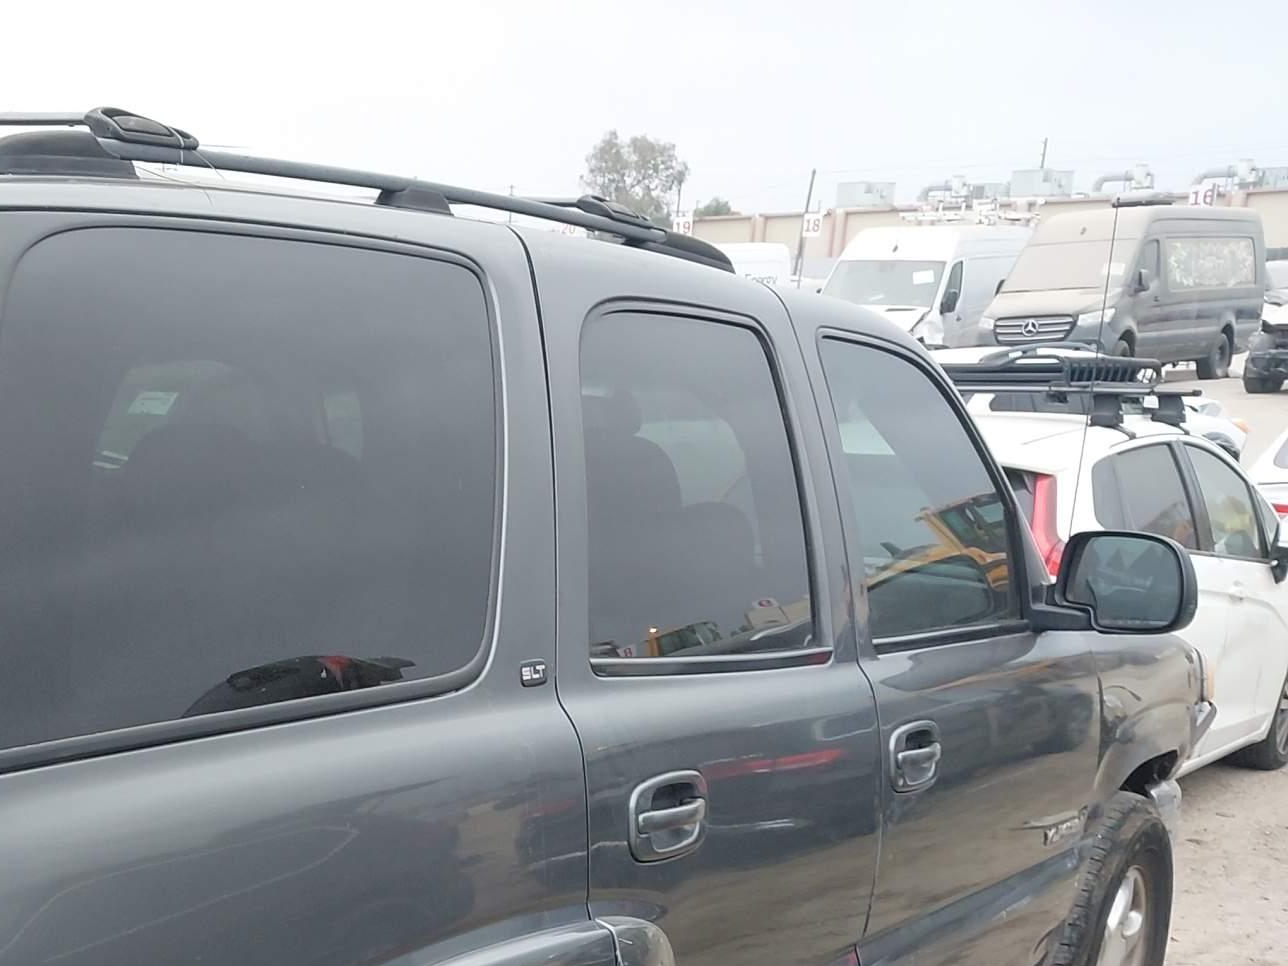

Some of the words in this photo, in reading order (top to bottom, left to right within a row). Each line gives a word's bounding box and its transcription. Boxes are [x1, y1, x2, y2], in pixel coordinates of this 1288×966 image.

[675, 221, 691, 233] 19
[804, 218, 821, 232] 18
[521, 664, 546, 681] SLT
